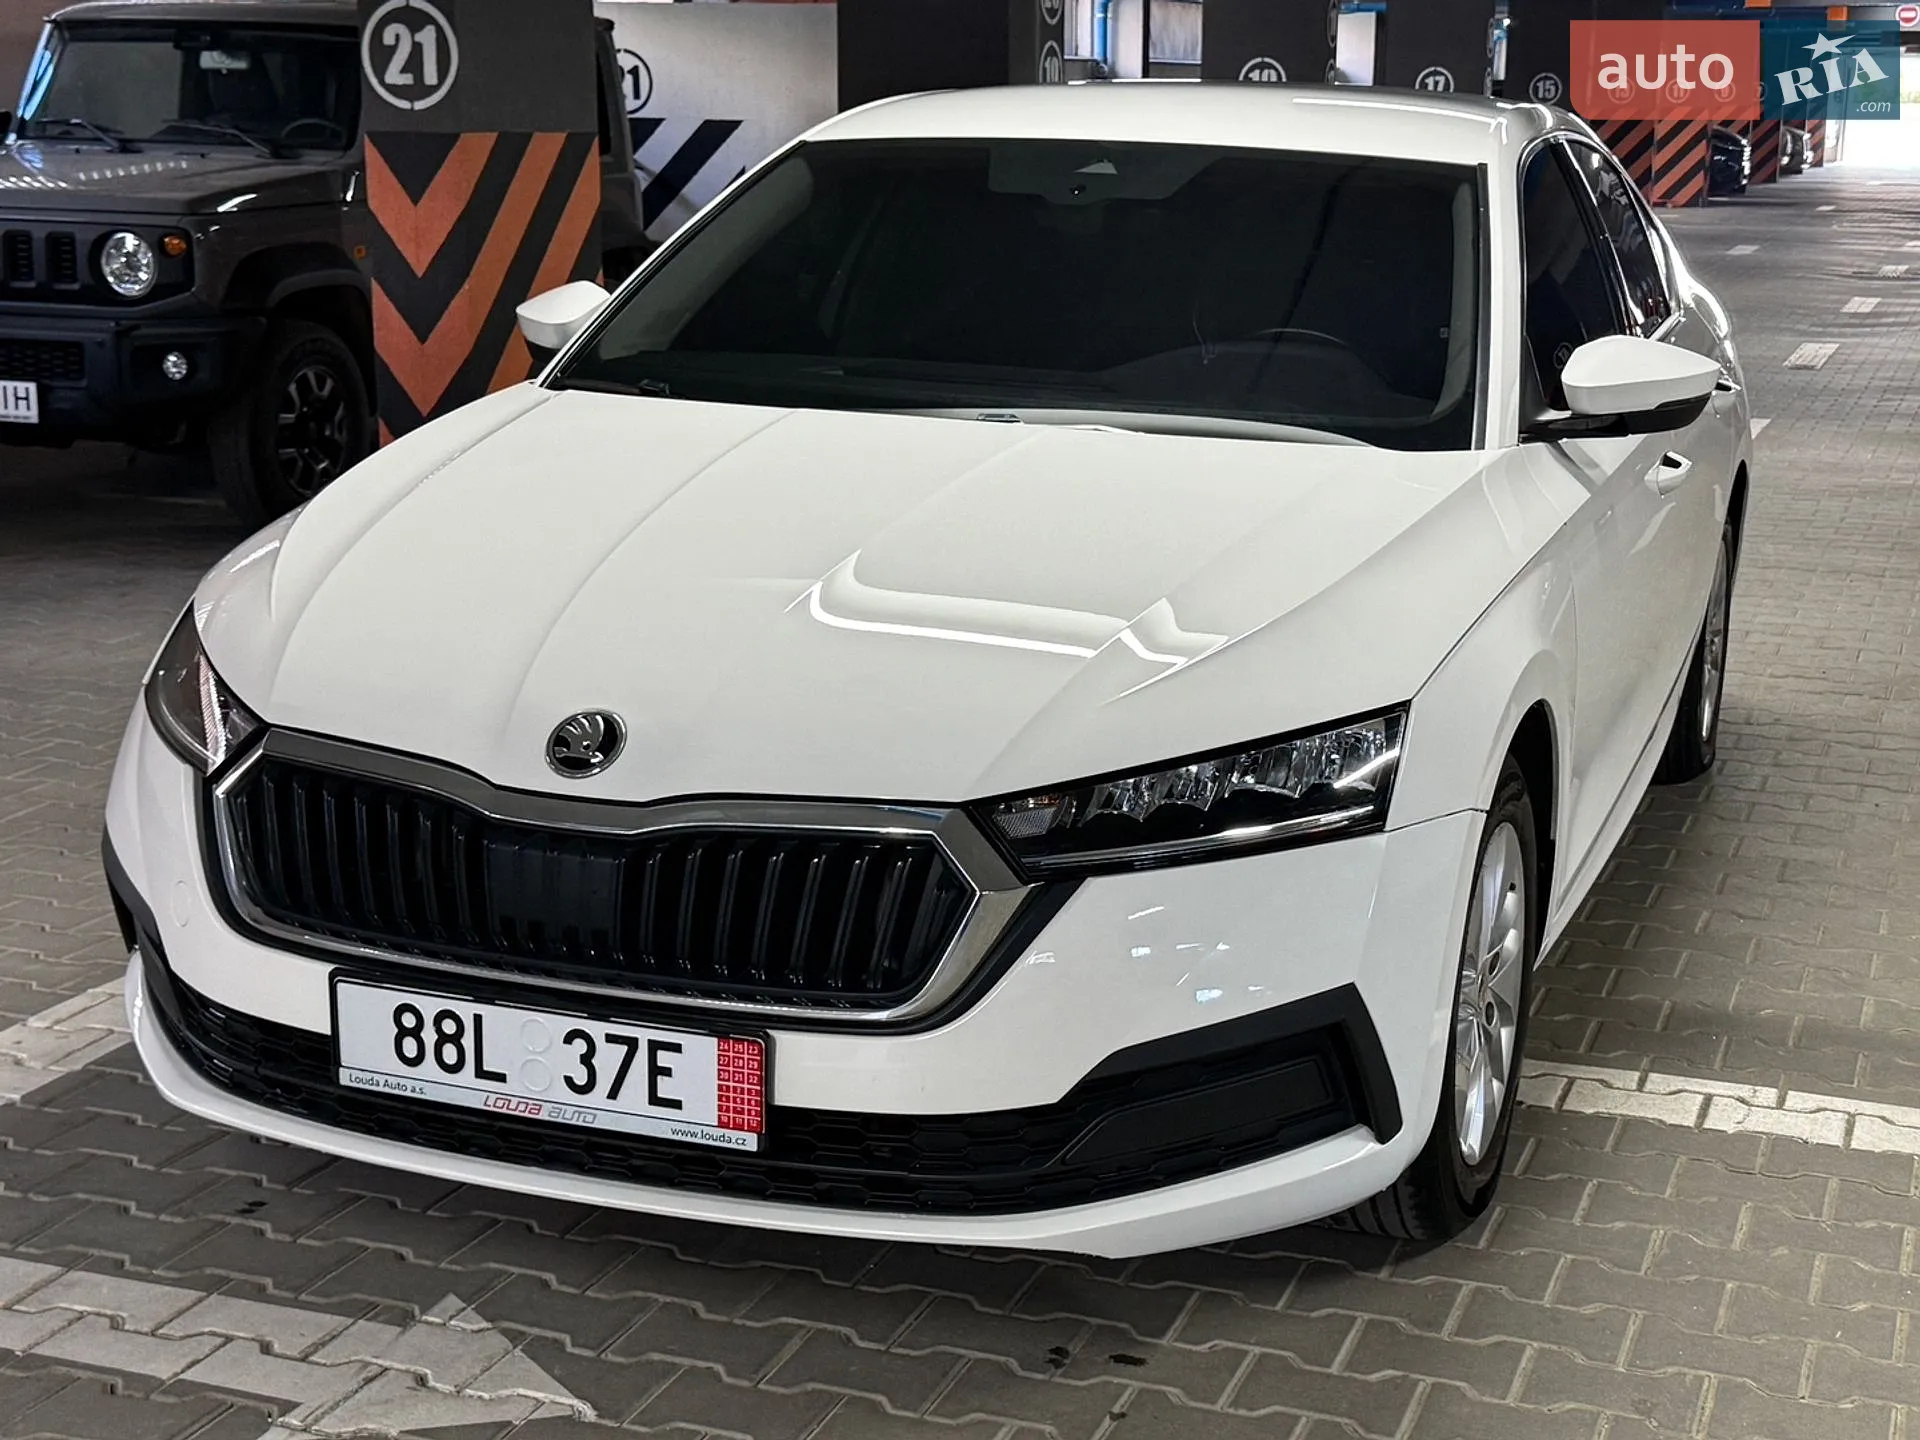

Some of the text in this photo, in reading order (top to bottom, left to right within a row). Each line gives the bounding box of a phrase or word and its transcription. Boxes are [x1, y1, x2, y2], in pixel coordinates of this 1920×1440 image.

[382, 23, 438, 86] 21
[1424, 75, 1445, 92] 17
[1536, 80, 1556, 98] 15
[392, 1002, 683, 1111] 88L 37E
[349, 1072, 380, 1088] Louda
[383, 1078, 408, 1092] Auto
[671, 1127, 747, 1146] www.louda.cz
